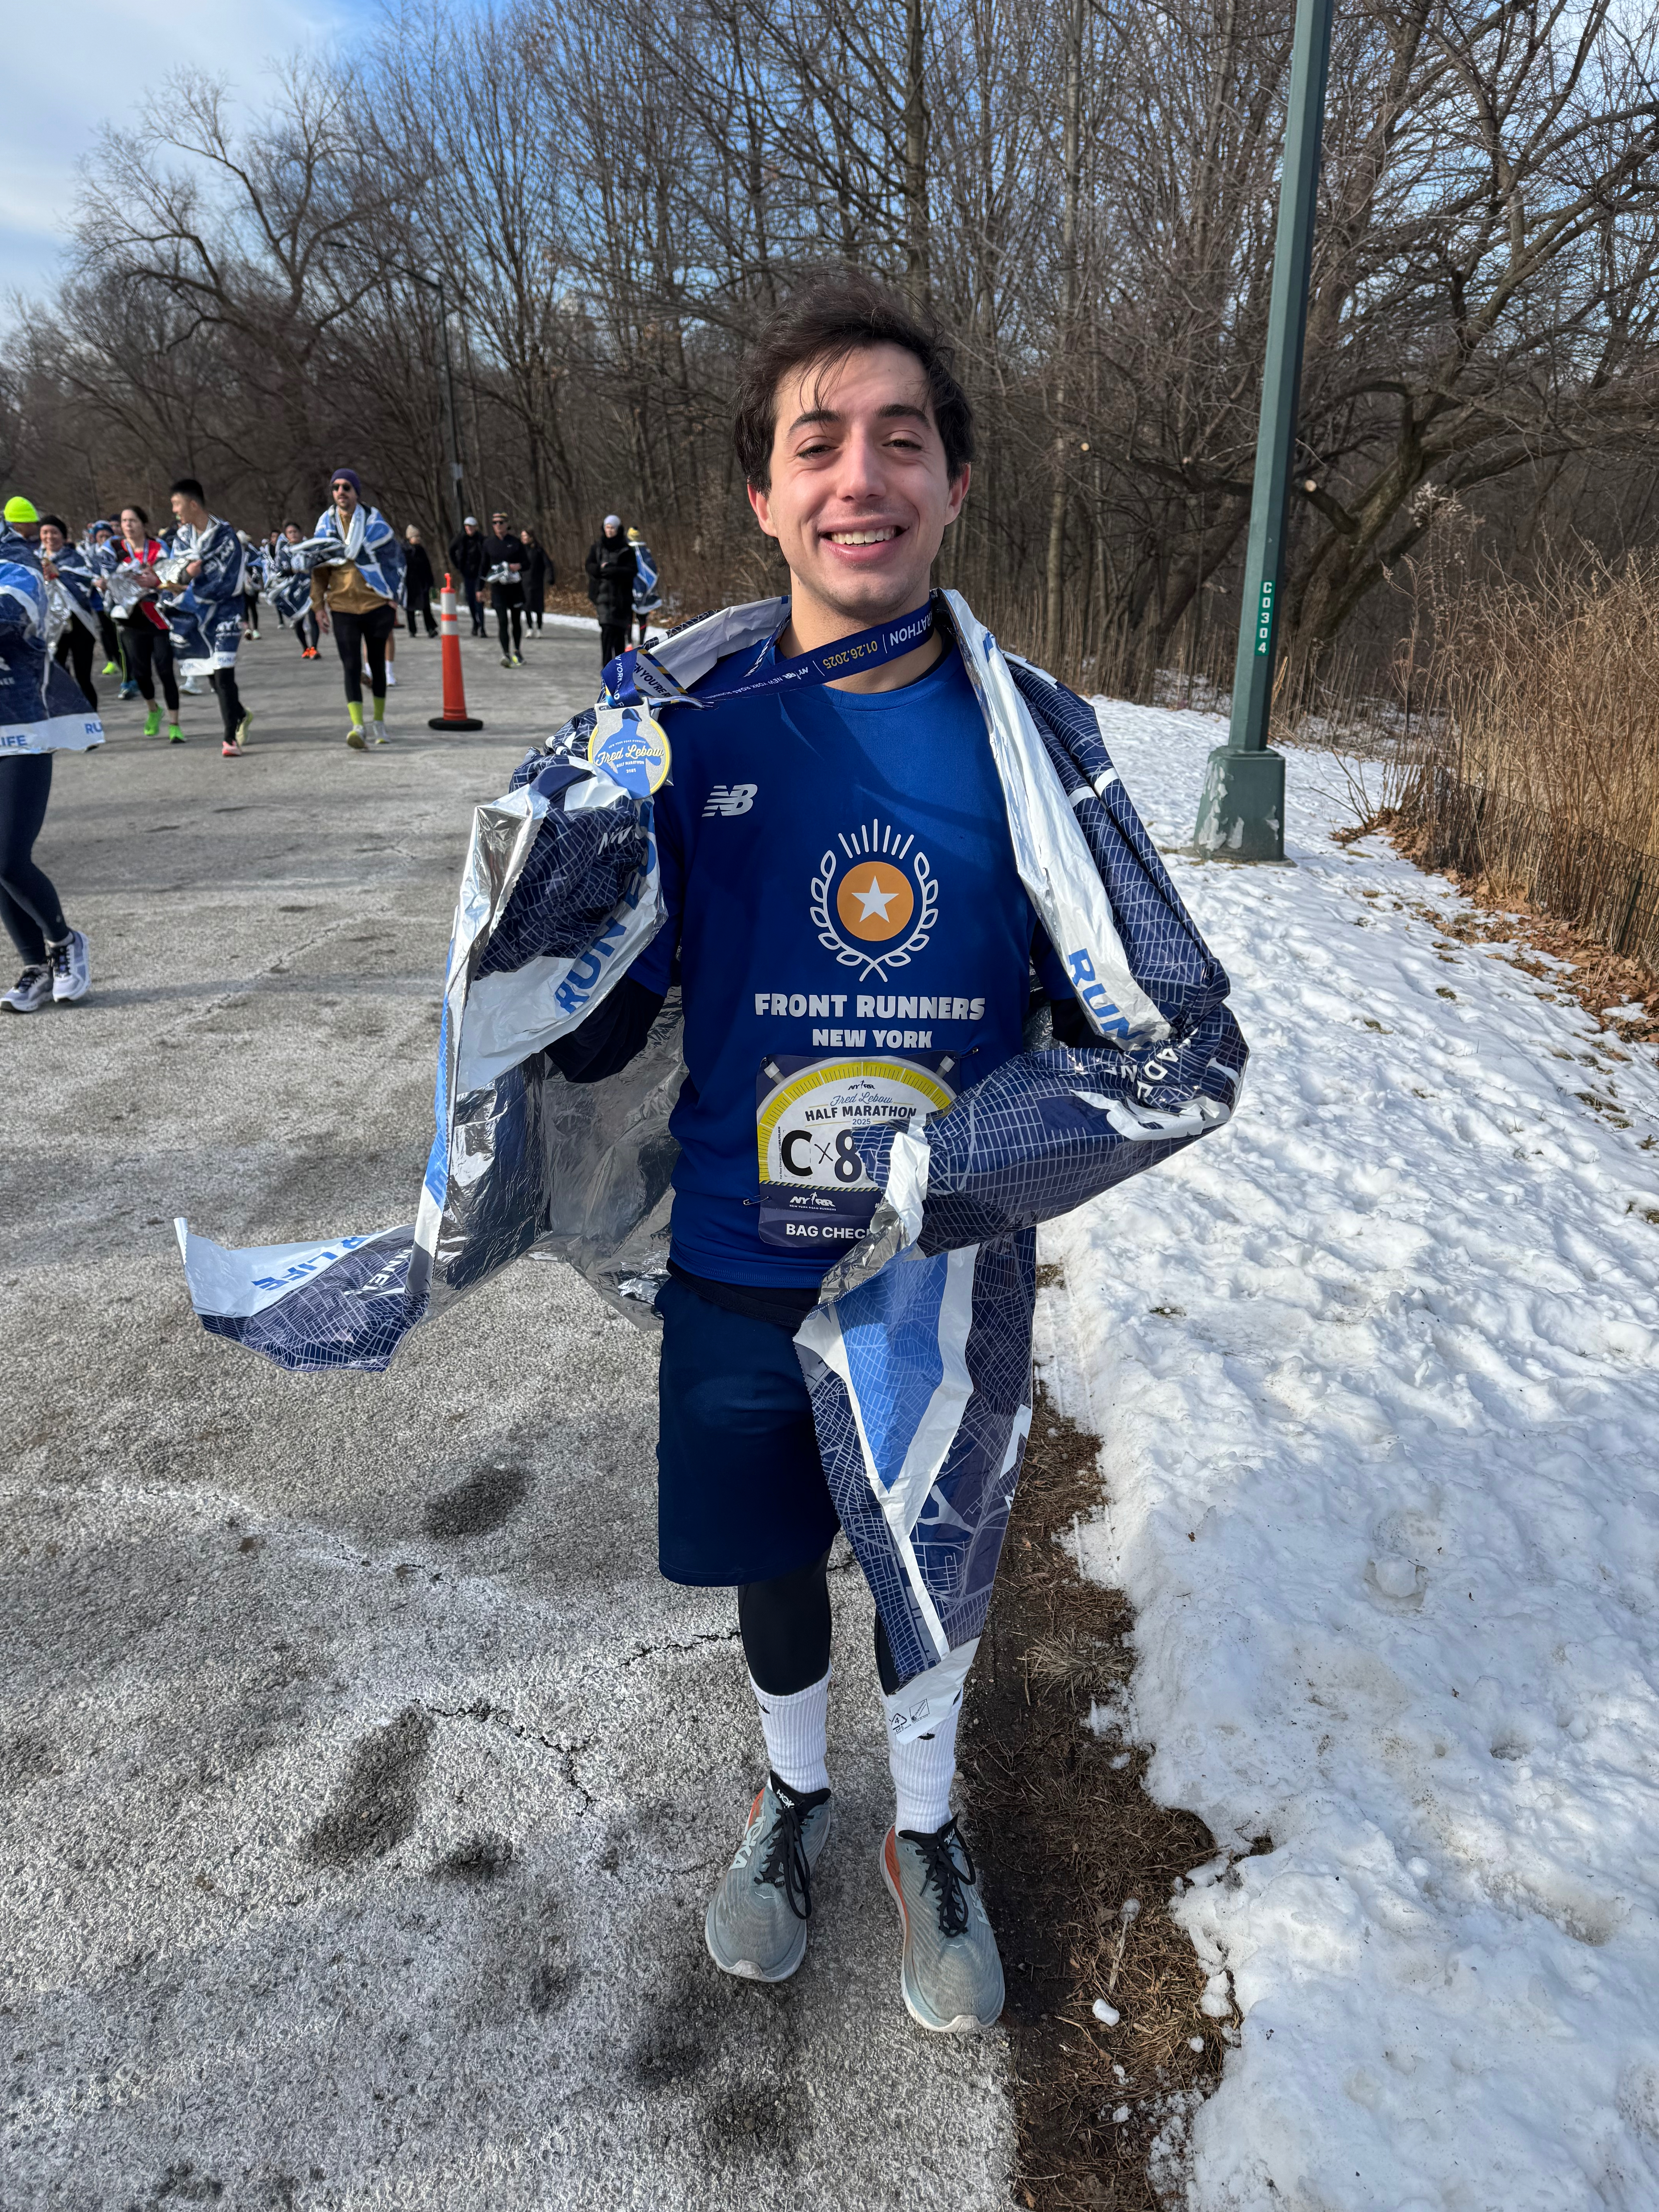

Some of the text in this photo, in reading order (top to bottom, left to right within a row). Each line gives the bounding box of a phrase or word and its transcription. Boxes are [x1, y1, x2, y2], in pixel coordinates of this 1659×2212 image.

[890, 611, 933, 646] RATHON
[1258, 582, 1273, 653] C0304
[823, 641, 878, 669] 01.26.2025
[640, 670, 665, 694] YOU'RE
[768, 676, 783, 685] NEW
[0, 722, 103, 746] IFE RU
[595, 744, 664, 766] Fred Lebow
[554, 917, 627, 1014] RUN
[755, 993, 986, 1020] FRONT RUNNERS
[813, 1029, 933, 1049] NEW YORK
[830, 1092, 893, 1106] Fred Lebow
[805, 1105, 917, 1121] HALF MARATHON
[781, 1129, 813, 1177] C
[790, 1194, 836, 1207] NYRR
[786, 1223, 818, 1237] BAG
[251, 1251, 338, 1291] LIFE
[776, 1789, 795, 1809] HOK
